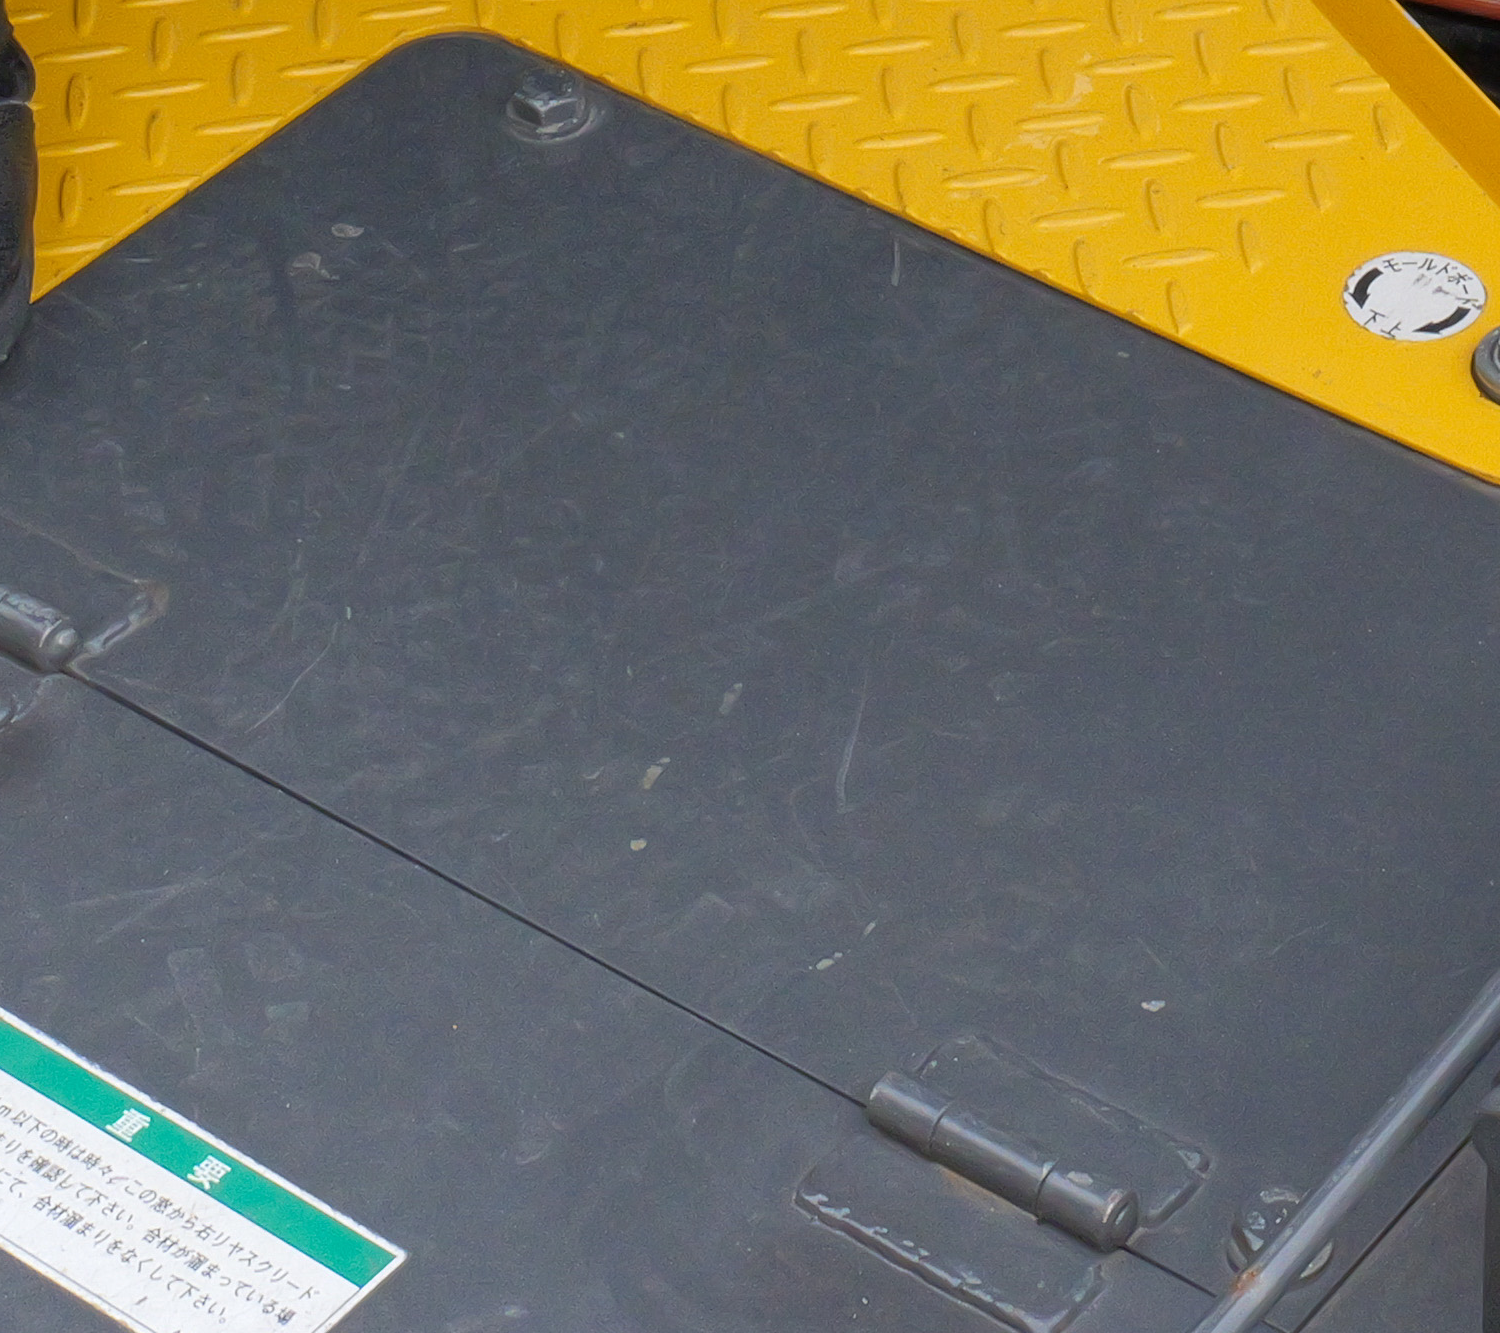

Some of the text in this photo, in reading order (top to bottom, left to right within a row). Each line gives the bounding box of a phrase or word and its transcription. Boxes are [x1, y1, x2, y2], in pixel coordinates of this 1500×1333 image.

[1382, 257, 1483, 311] モールドボード
[1364, 309, 1386, 326] 下
[1381, 321, 1402, 339] 上
[102, 1105, 235, 1191] 重要
